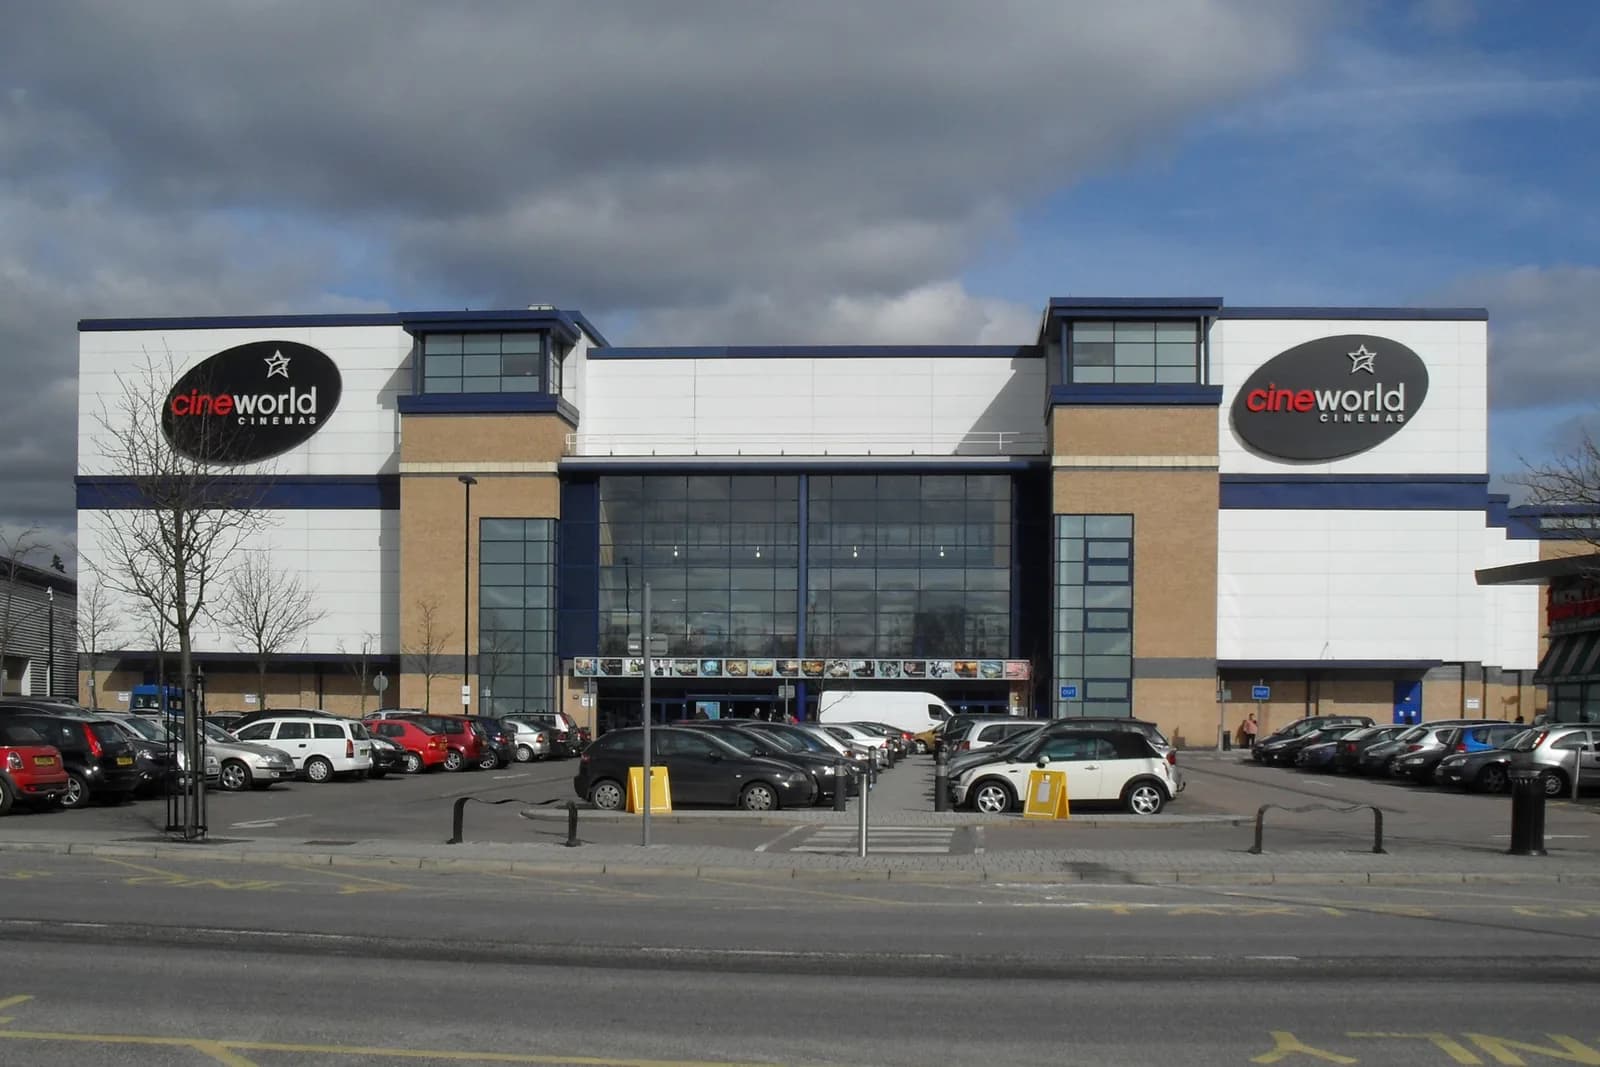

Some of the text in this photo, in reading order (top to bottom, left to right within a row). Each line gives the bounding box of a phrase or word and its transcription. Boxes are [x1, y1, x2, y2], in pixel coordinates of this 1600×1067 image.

[171, 386, 317, 416] cineworld
[1247, 382, 1405, 412] cineworld
[238, 416, 317, 425] CINEMAS
[1320, 413, 1404, 423] CINEMAS
[1249, 1029, 1600, 1066] NLY
